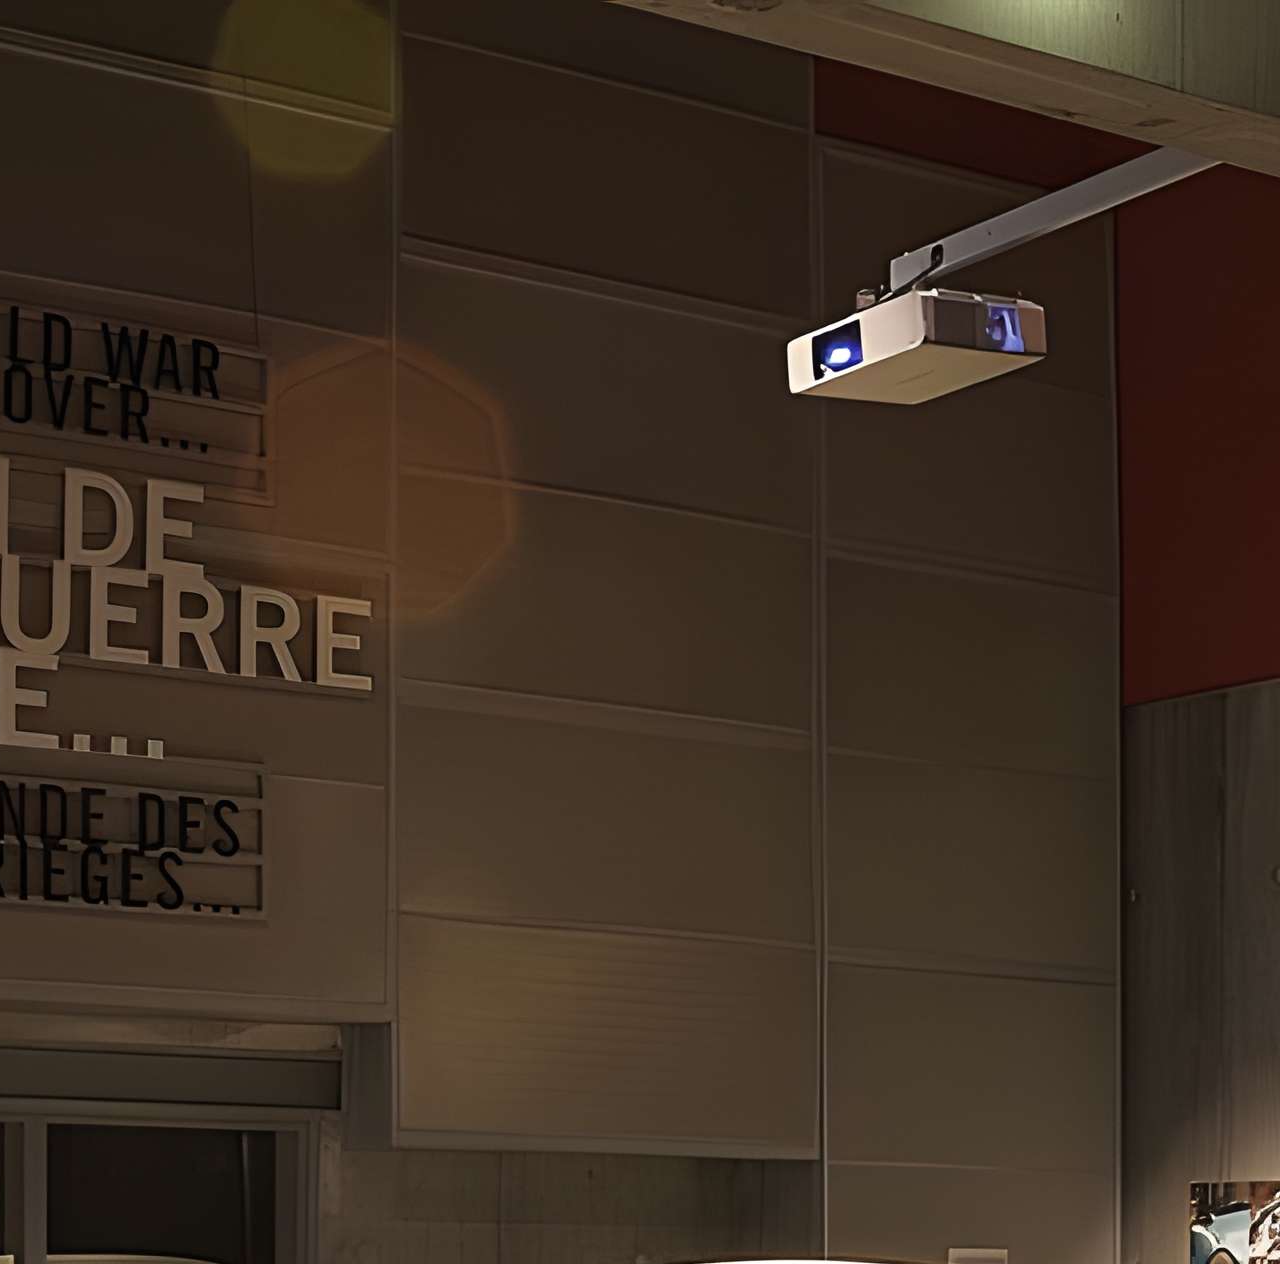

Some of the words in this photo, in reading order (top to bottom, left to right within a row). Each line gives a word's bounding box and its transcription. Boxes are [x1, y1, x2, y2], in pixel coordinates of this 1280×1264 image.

[101, 321, 221, 400] WAR
[2, 360, 210, 454] OVER...
[64, 467, 205, 575] DE
[137, 792, 241, 858] DES
